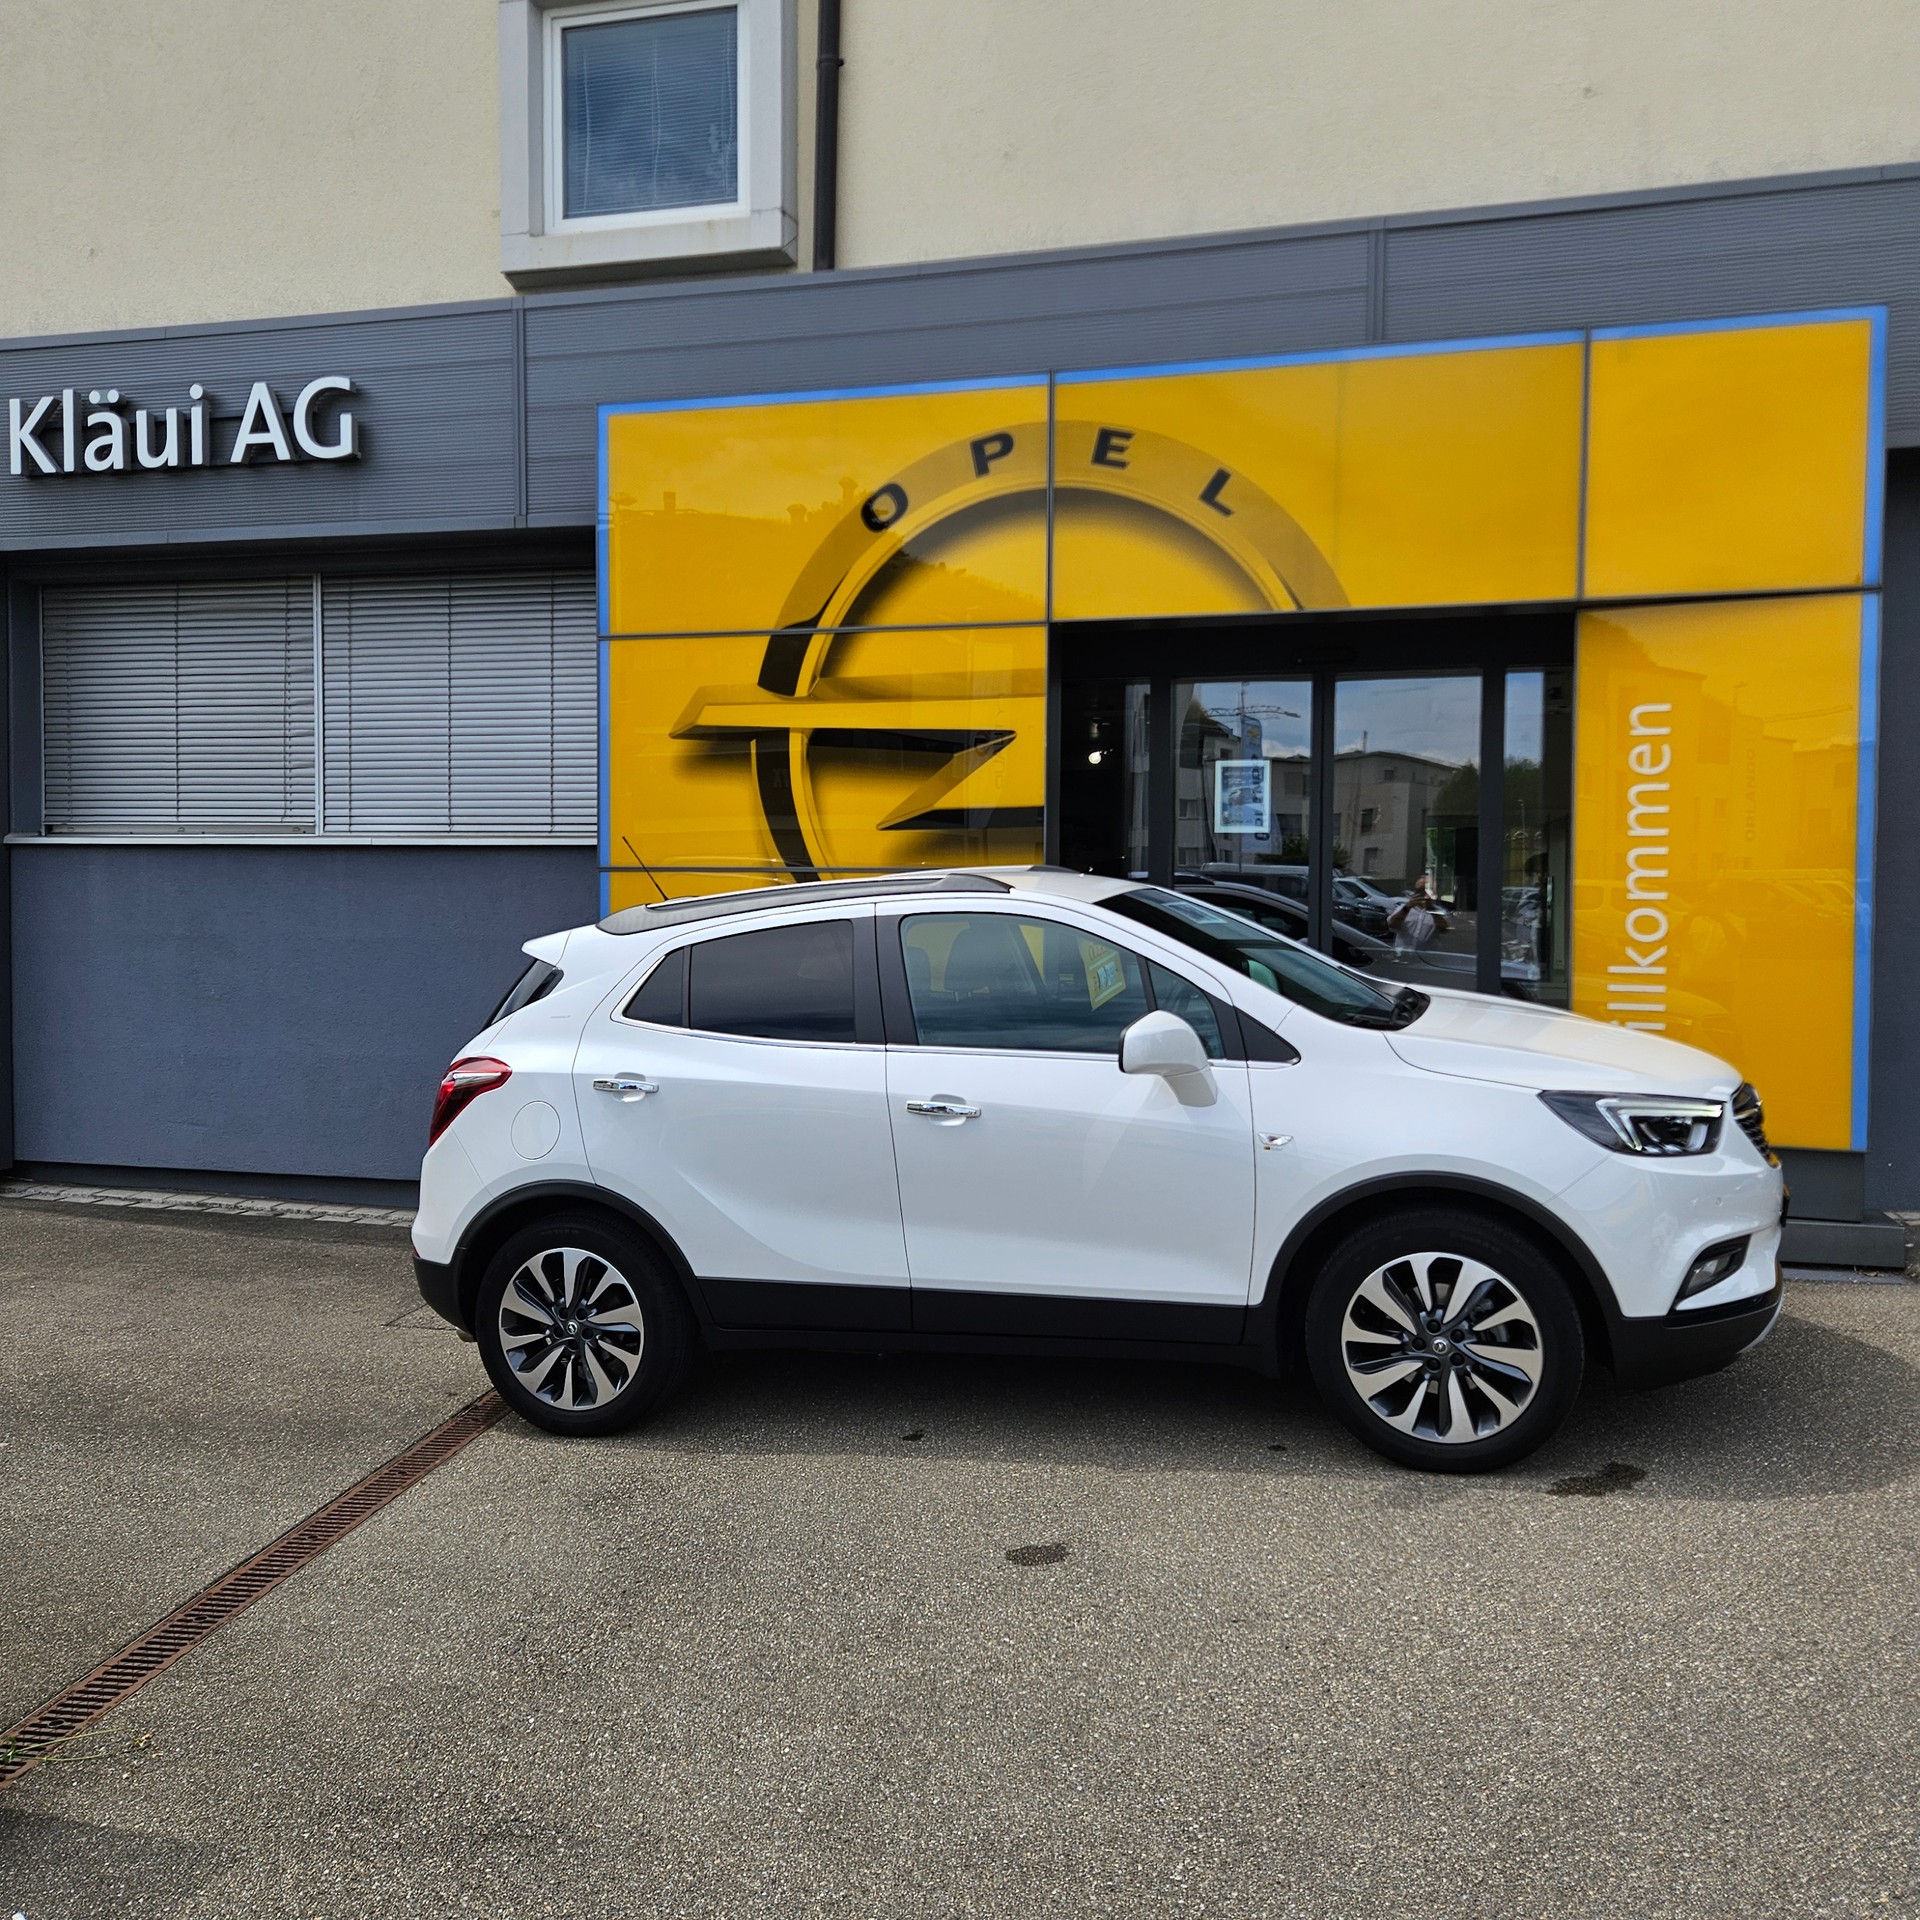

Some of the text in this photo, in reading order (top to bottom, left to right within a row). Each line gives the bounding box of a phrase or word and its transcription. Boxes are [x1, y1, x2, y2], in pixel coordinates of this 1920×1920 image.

[9, 376, 355, 475] Kläui AG
[860, 426, 1236, 532] OPEL
[1606, 702, 1673, 1032] illkommen
